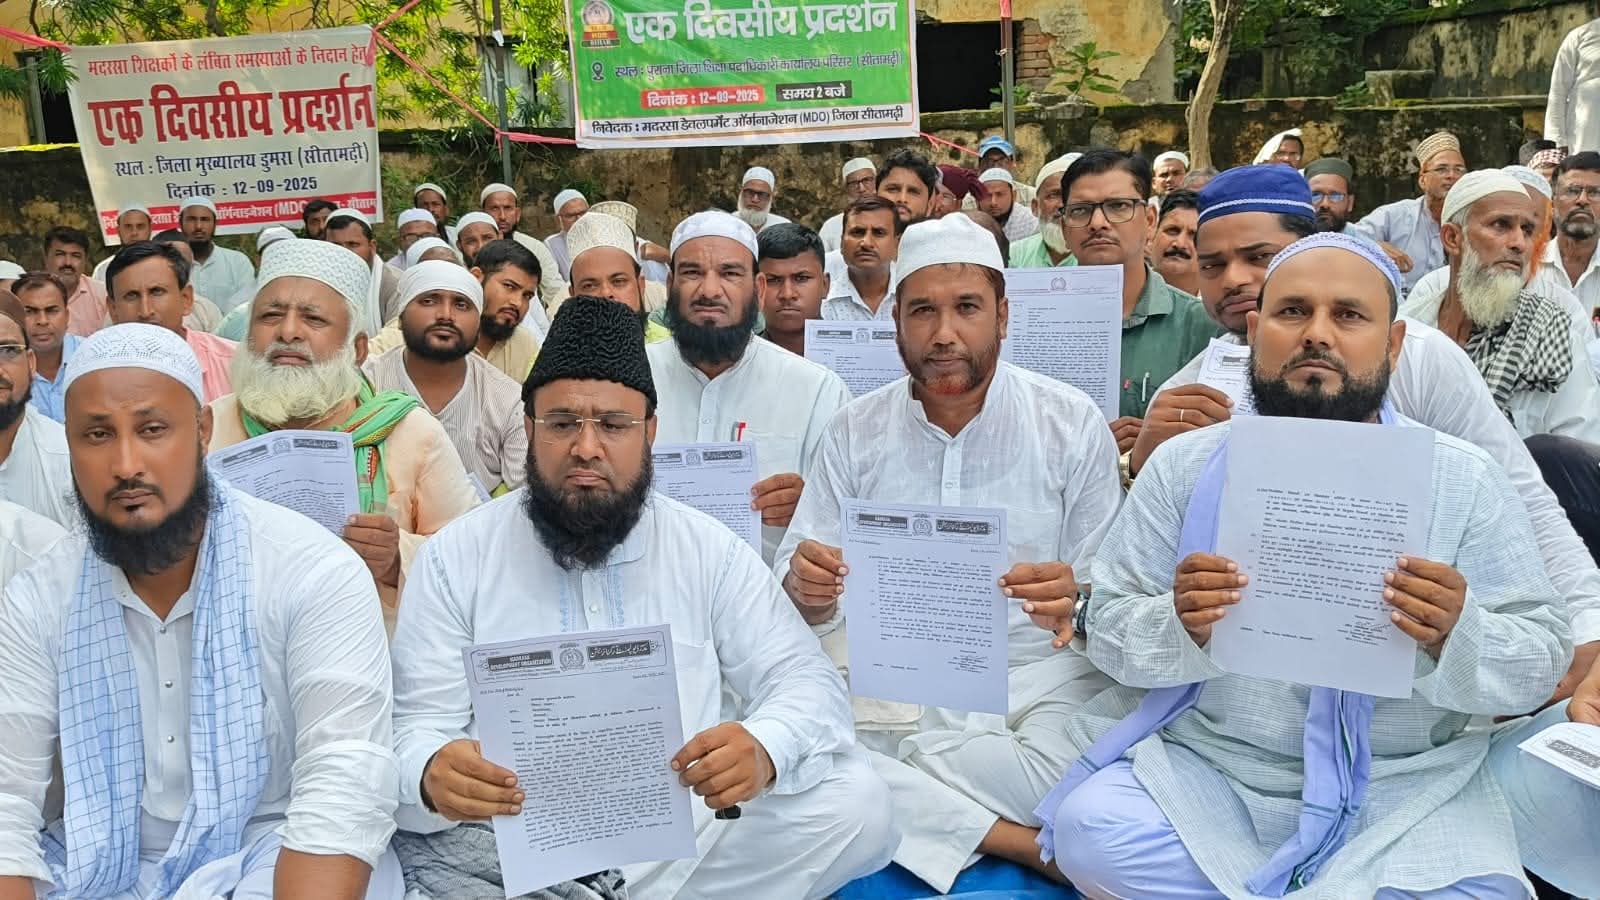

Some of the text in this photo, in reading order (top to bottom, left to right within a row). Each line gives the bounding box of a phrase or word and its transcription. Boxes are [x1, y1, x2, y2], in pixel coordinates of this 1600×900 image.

[624, 0, 898, 44] एक दिवसीय प्रदर्शन
[88, 59, 128, 76] मदरसा
[132, 54, 178, 74] शिक्षकों
[181, 52, 193, 71] के
[197, 51, 232, 70] लंबित
[235, 47, 292, 69] समस्याओं
[297, 46, 308, 65] के
[312, 45, 347, 64] निदान
[615, 65, 638, 77] स्थल
[676, 59, 702, 75] जिला
[647, 91, 688, 108] दिनांक
[699, 88, 760, 104] 12-09-2025
[782, 83, 846, 100] समय 2 बजे
[88, 73, 376, 146] एक दिवसीय प्रदर्शन
[592, 120, 632, 134] निवेदक
[642, 121, 679, 133] मदरसा
[680, 115, 731, 131] डेवलपमेंट
[732, 112, 797, 127] ऑर्गनाजेशन
[799, 111, 830, 126] (MDO)
[832, 108, 859, 122] जिला
[861, 105, 904, 121] सीतामढ़ी
[115, 161, 144, 177] स्थल
[156, 155, 192, 173] जिला
[195, 153, 257, 177] मुख्यालय
[260, 151, 293, 173] डुमरा
[298, 141, 369, 168] (सीतामढ़ी)
[166, 180, 216, 199] दिनांक
[233, 177, 318, 196] 12-09-2025
